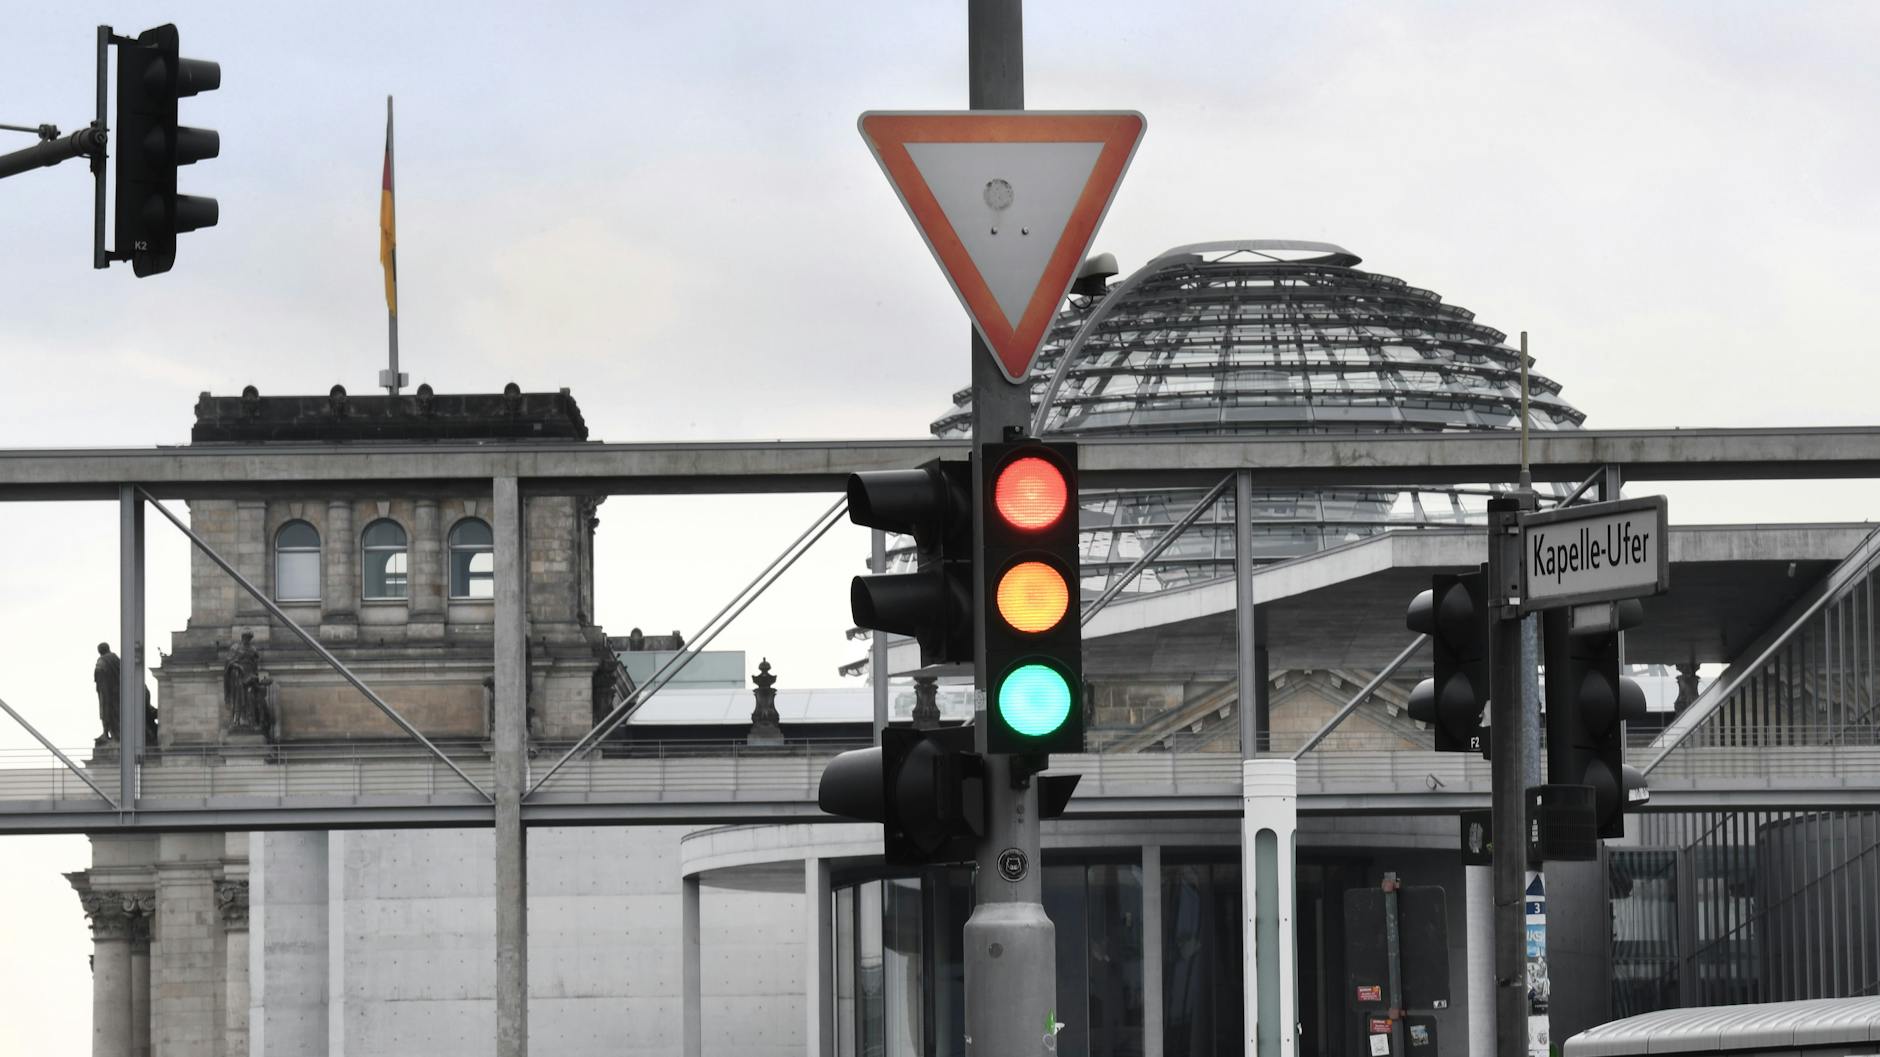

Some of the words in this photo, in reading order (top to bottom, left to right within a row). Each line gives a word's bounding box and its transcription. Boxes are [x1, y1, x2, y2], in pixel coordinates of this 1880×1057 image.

[135, 240, 147, 250] K2
[1534, 521, 1649, 584] Kapelle-Ufer
[1470, 736, 1480, 749] F2
[1534, 902, 1541, 914] 3
